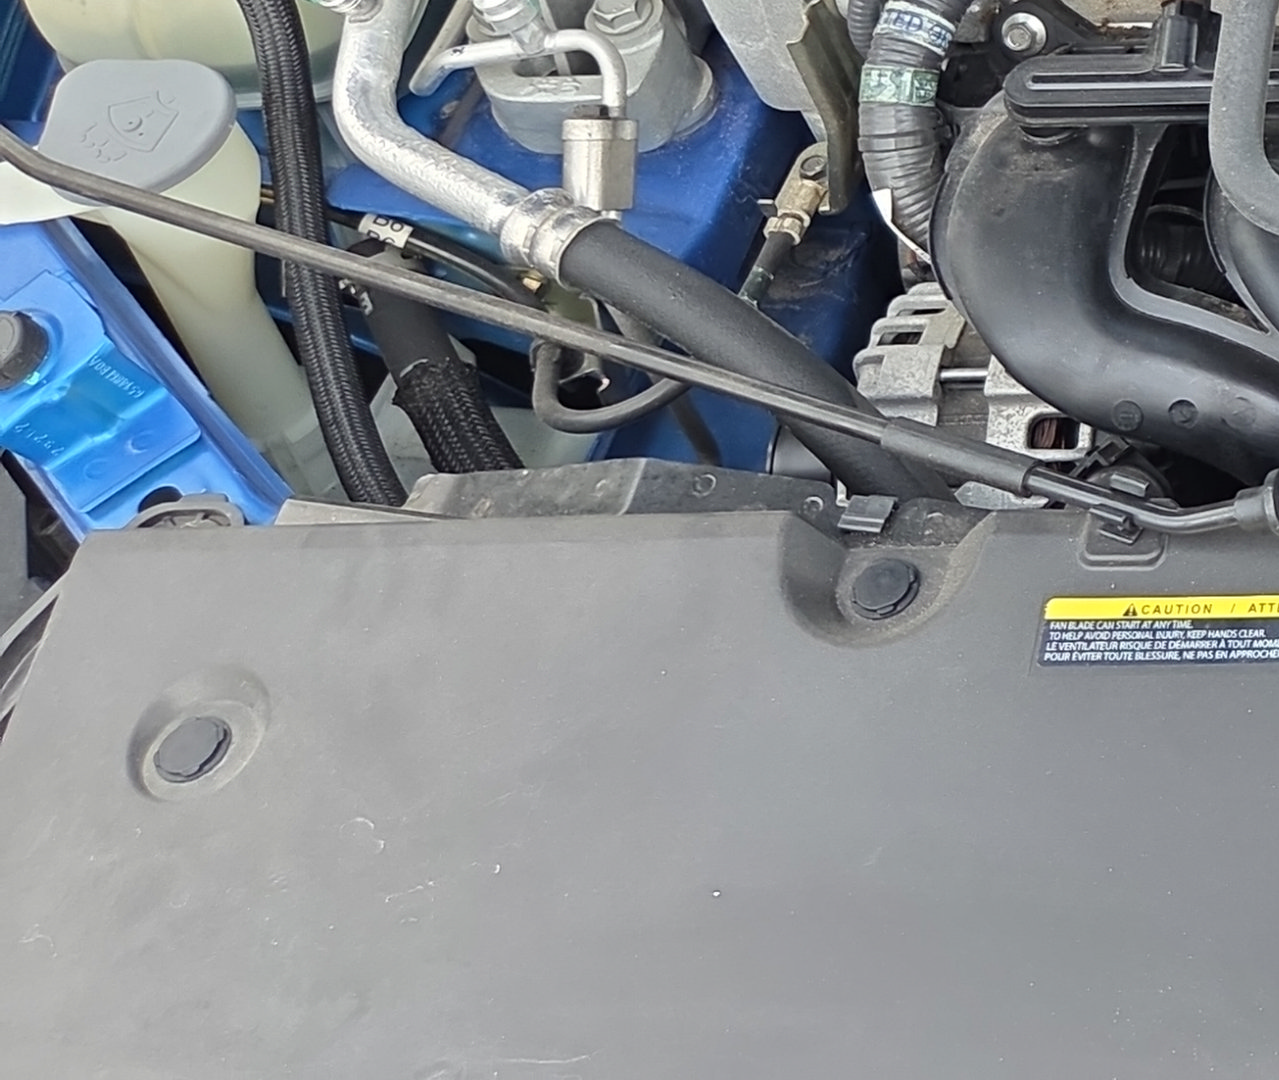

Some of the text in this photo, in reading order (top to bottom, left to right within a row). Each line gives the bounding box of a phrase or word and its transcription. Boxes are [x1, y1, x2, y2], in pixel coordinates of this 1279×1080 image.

[1141, 603, 1213, 615] CAUTION
[1050, 620, 1194, 630] FAN BLADE CAN START AT ANY TIME.
[1050, 629, 1266, 640] TO HELP AVOID PERSONAL INJURY, KEEP HANDS CLEAR.
[1046, 641, 1059, 651] LE
[1059, 641, 1119, 650] VENTILATEUR
[1120, 641, 1153, 651] RISQUE
[1153, 641, 1167, 650] DE
[1168, 639, 1218, 650] DÉMARRER
[1218, 638, 1227, 649] À
[1227, 639, 1252, 649] TOUT
[1044, 652, 1071, 661] POUR
[1071, 650, 1102, 661] ÉVITER
[1103, 651, 1134, 660] TOUTE
[1135, 651, 1181, 661] BLESSURE,
[1183, 651, 1195, 660] NE
[1197, 650, 1213, 659] PAS
[1215, 650, 1228, 659] EN
